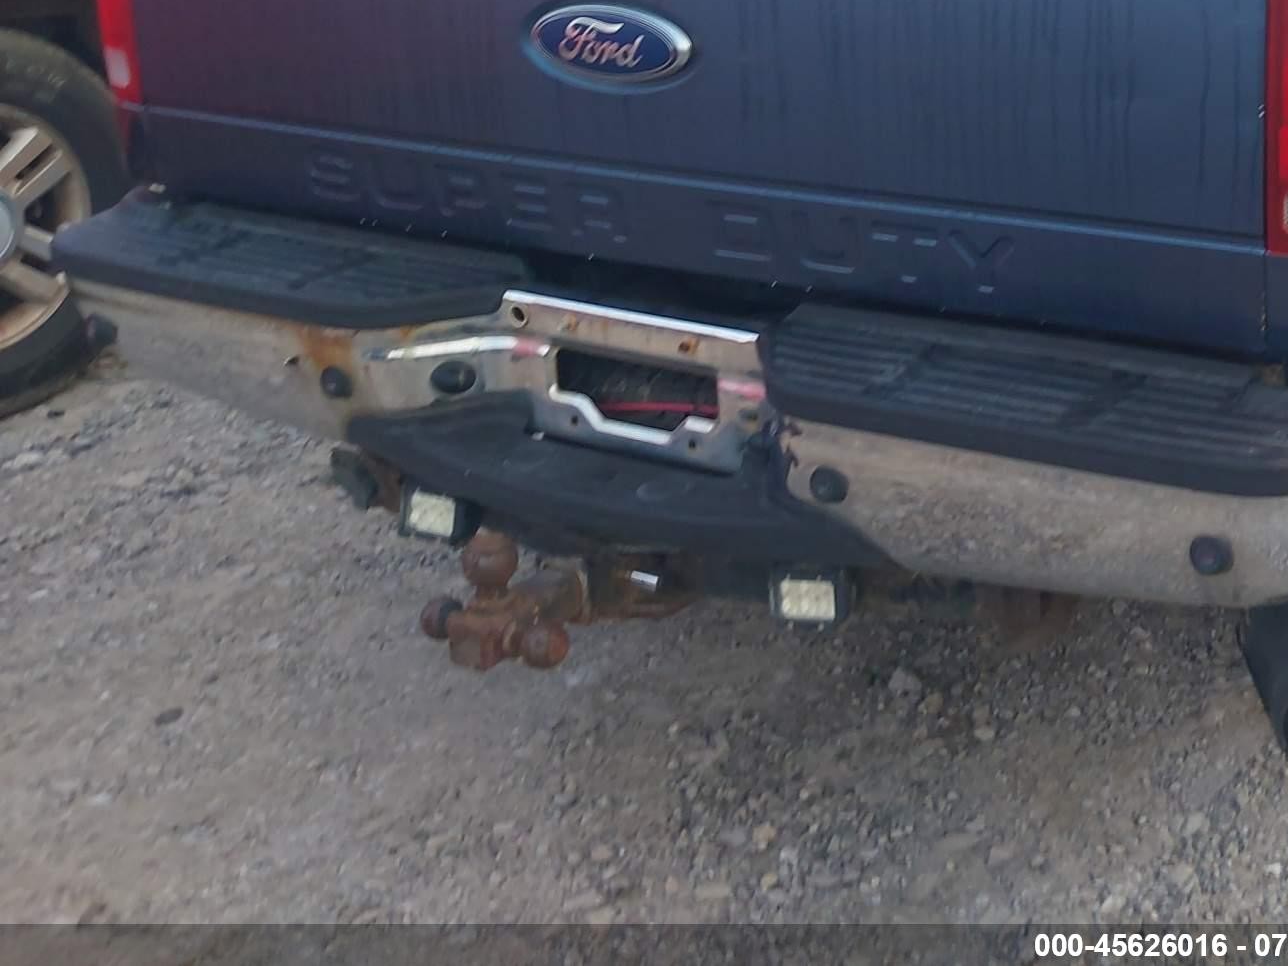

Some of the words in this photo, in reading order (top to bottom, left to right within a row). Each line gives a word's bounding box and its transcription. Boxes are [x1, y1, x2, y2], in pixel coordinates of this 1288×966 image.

[558, 16, 644, 68] Ford
[308, 149, 630, 244] SUPER
[706, 199, 1017, 294] DUTY
